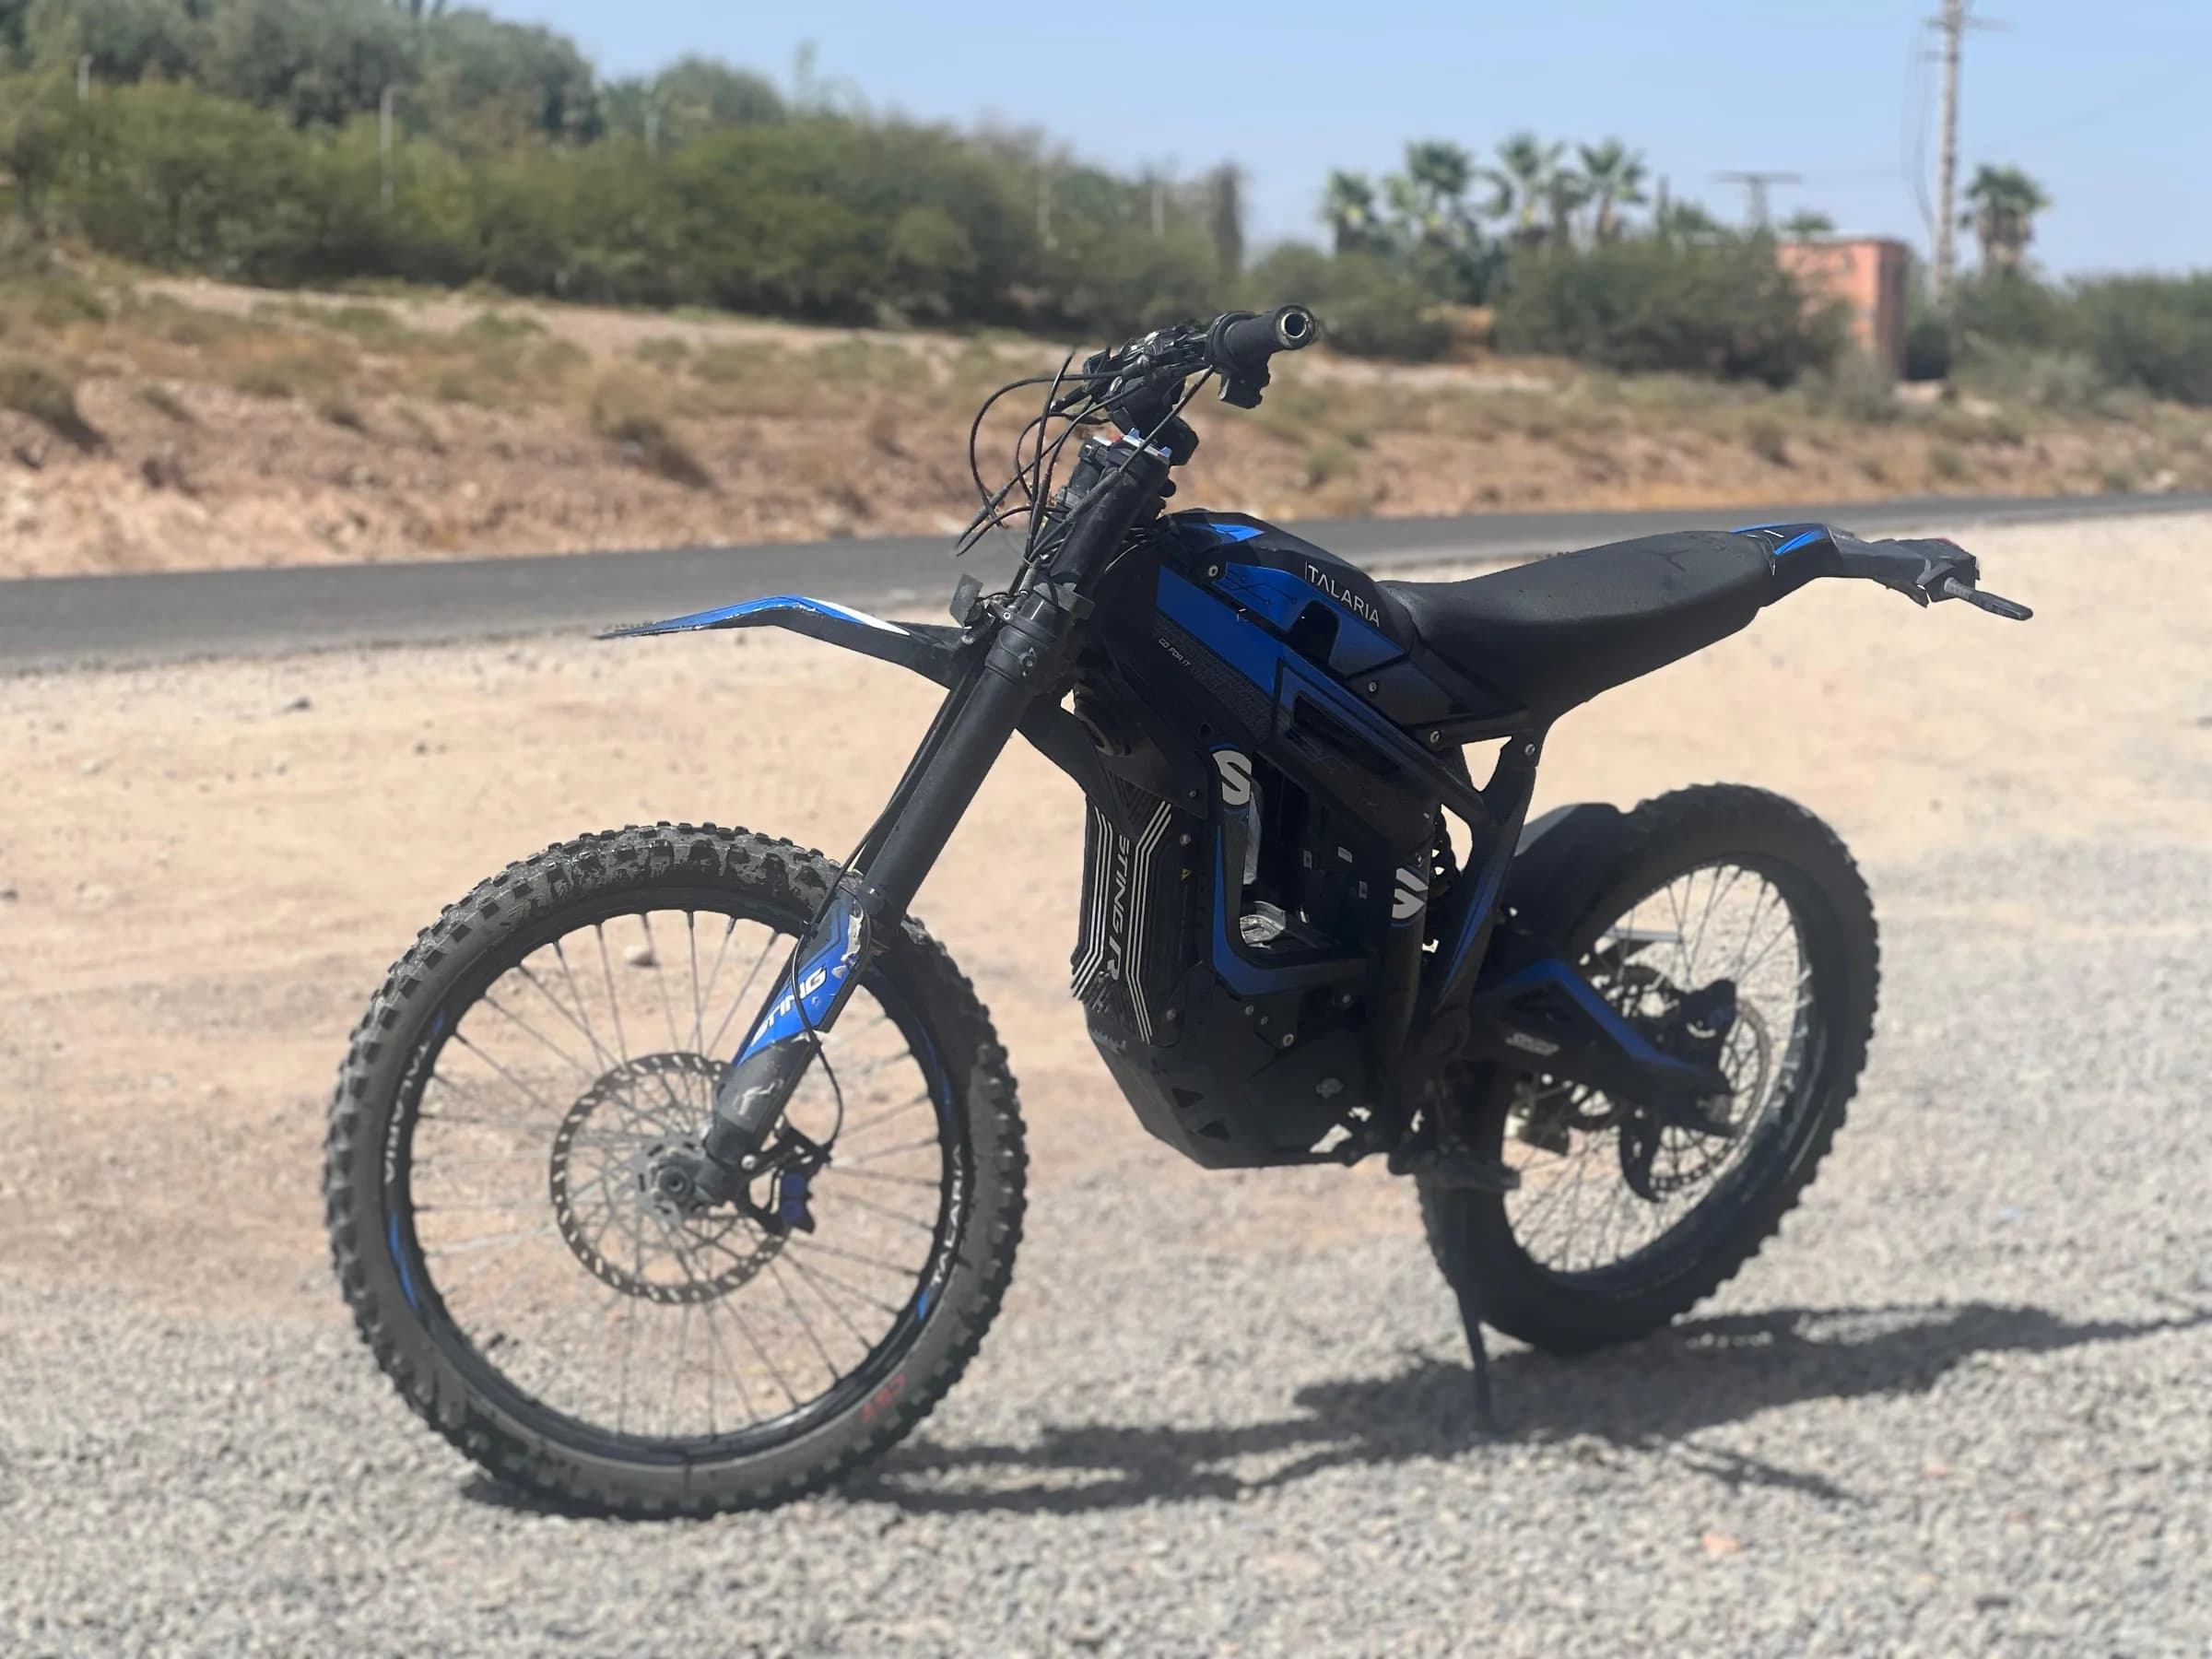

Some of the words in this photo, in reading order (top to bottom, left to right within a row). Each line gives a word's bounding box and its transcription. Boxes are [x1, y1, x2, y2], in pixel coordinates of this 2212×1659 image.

[1307, 564, 1380, 628] TALARIA
[1112, 833, 1130, 935] STING
[1107, 935, 1122, 981] R
